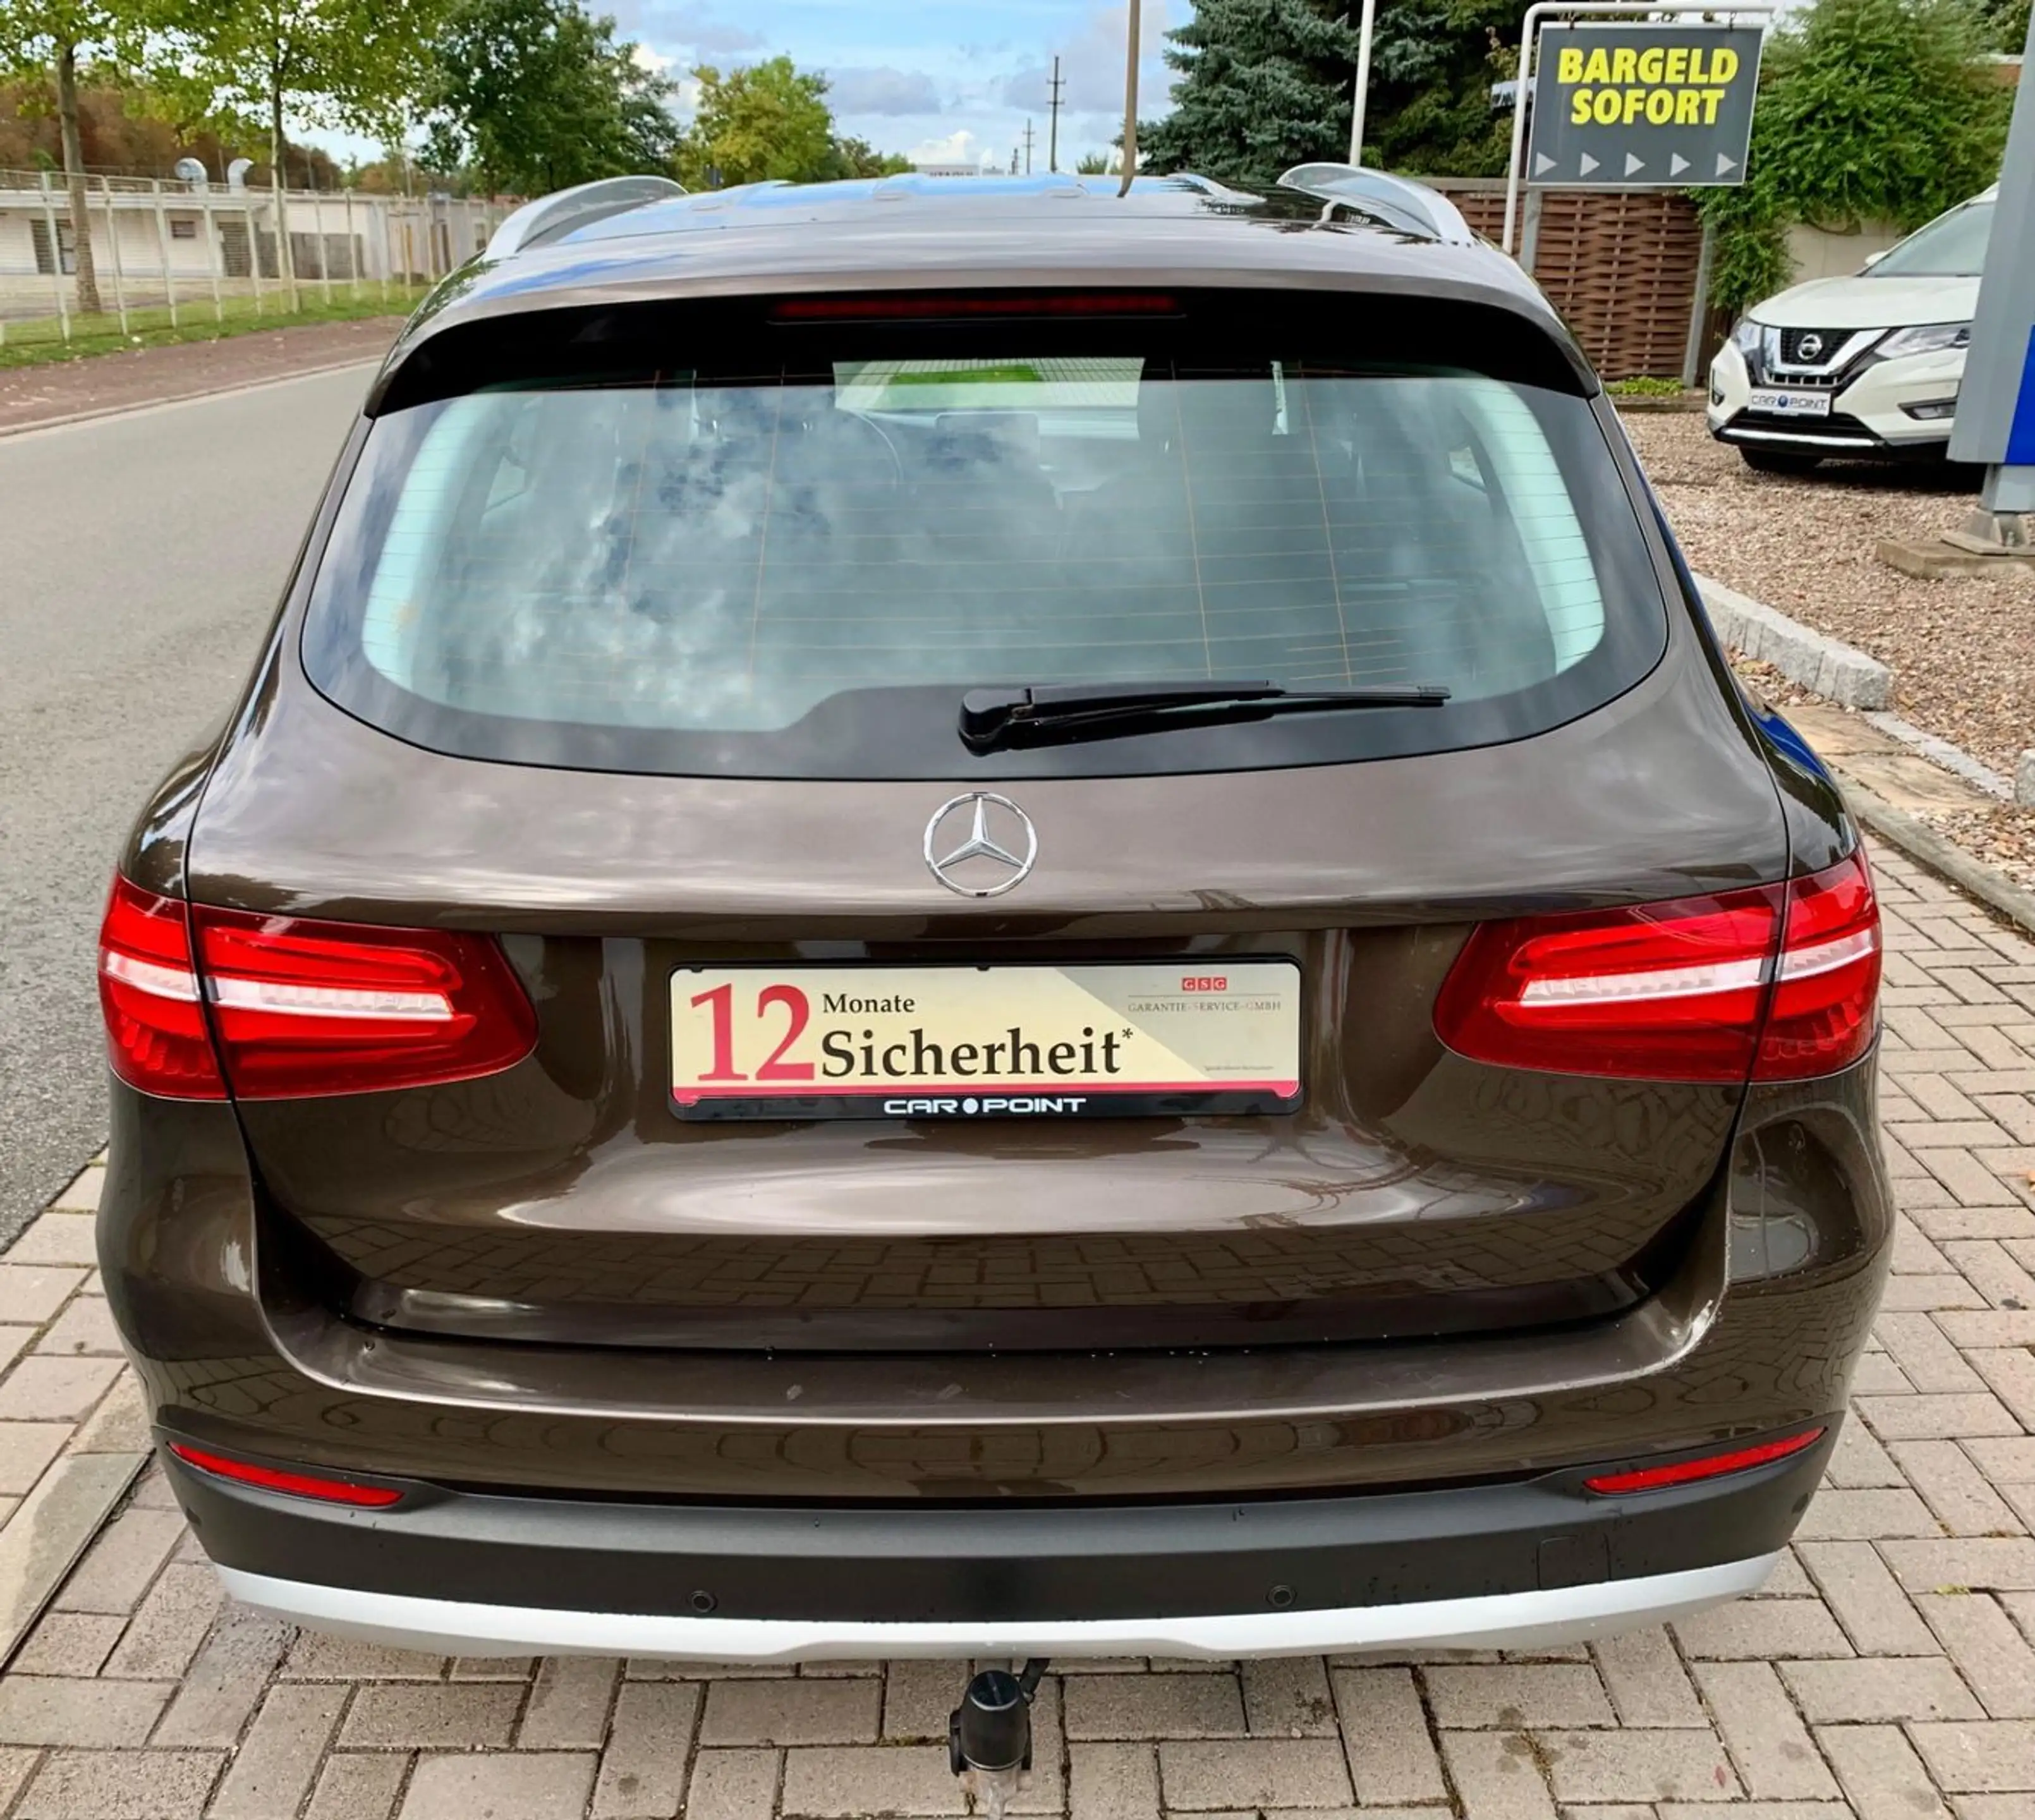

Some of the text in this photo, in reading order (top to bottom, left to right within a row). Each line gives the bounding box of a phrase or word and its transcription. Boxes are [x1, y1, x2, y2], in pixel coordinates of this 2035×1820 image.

[1557, 47, 1739, 84] BARGELD
[1570, 88, 1725, 125] SOFORT
[1751, 395, 1828, 410] CAR POINT
[1183, 978, 1226, 990] GSG
[691, 983, 915, 1081] 12 Monate
[884, 1098, 1087, 1114] CAR POINT
